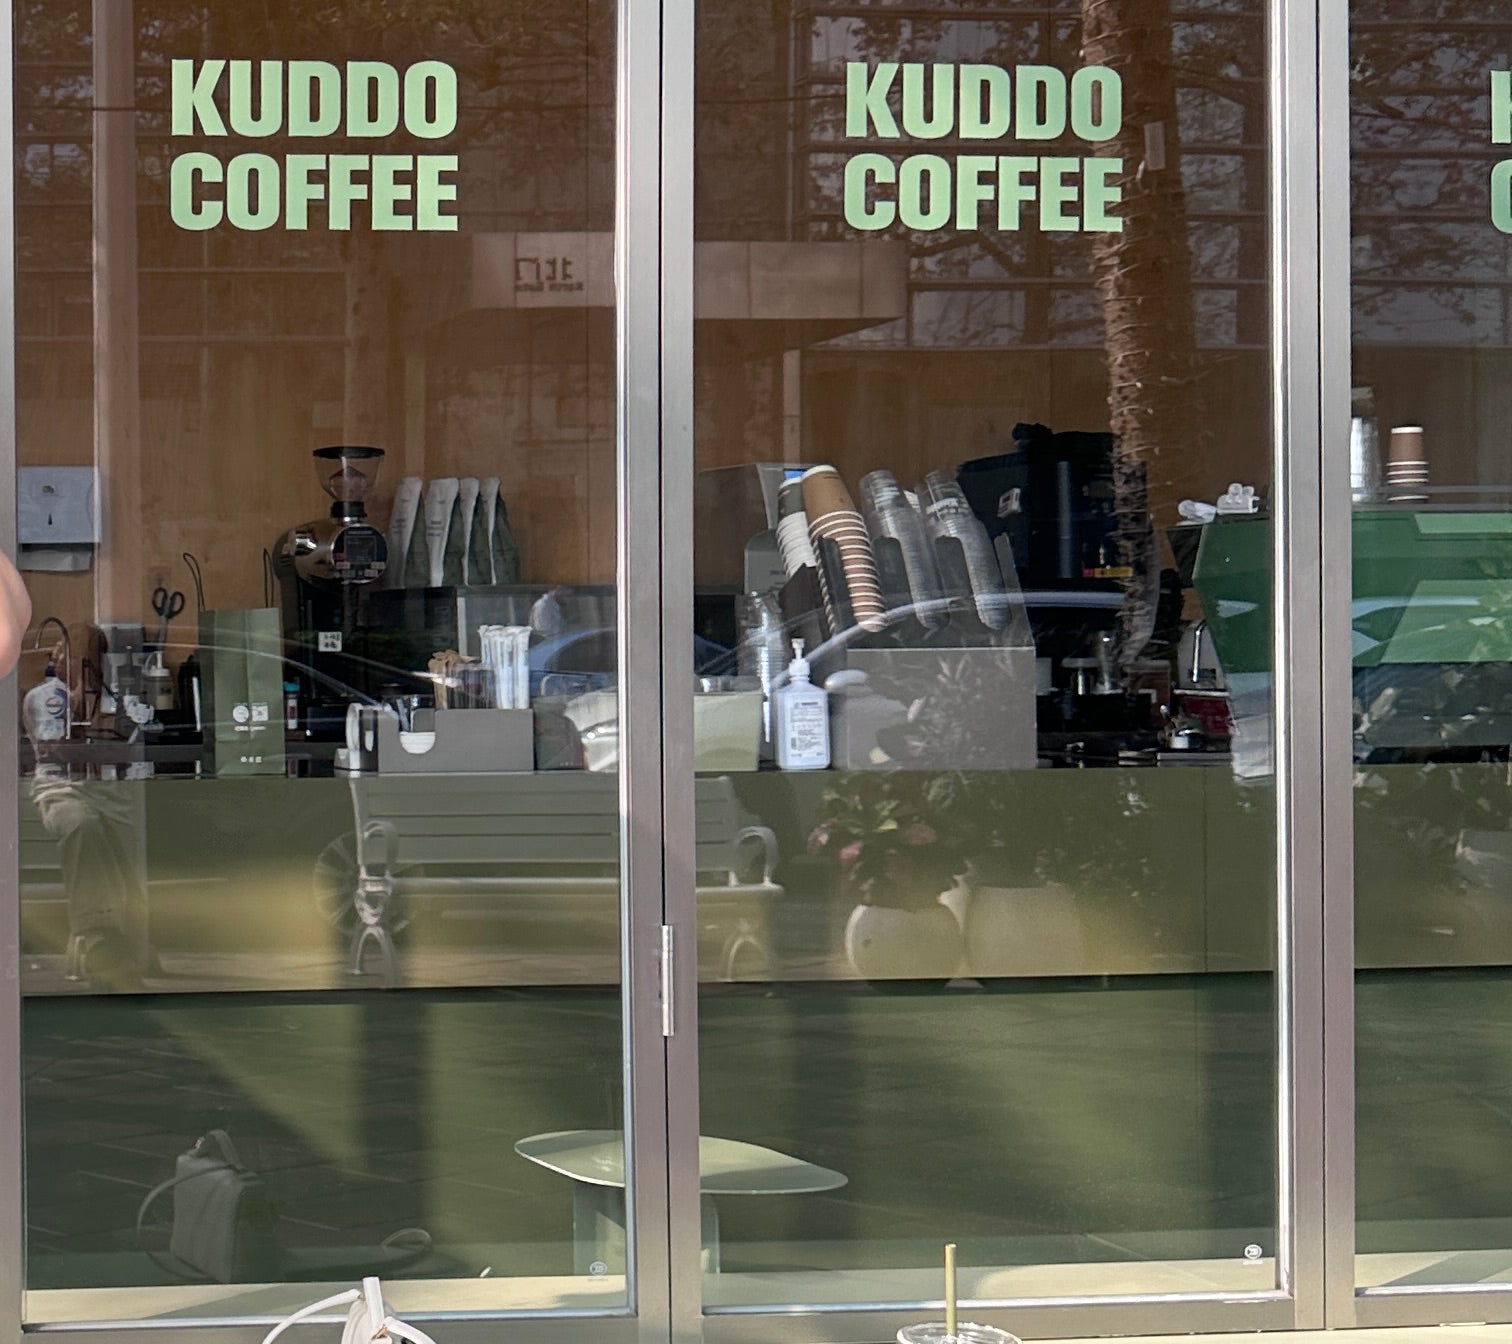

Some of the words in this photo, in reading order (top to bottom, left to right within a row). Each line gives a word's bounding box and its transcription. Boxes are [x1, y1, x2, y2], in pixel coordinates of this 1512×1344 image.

[171, 59, 457, 139] KUDDO
[845, 61, 1123, 142] KUDDO
[170, 152, 459, 232] COFFEE
[844, 152, 1124, 233] COFFEE
